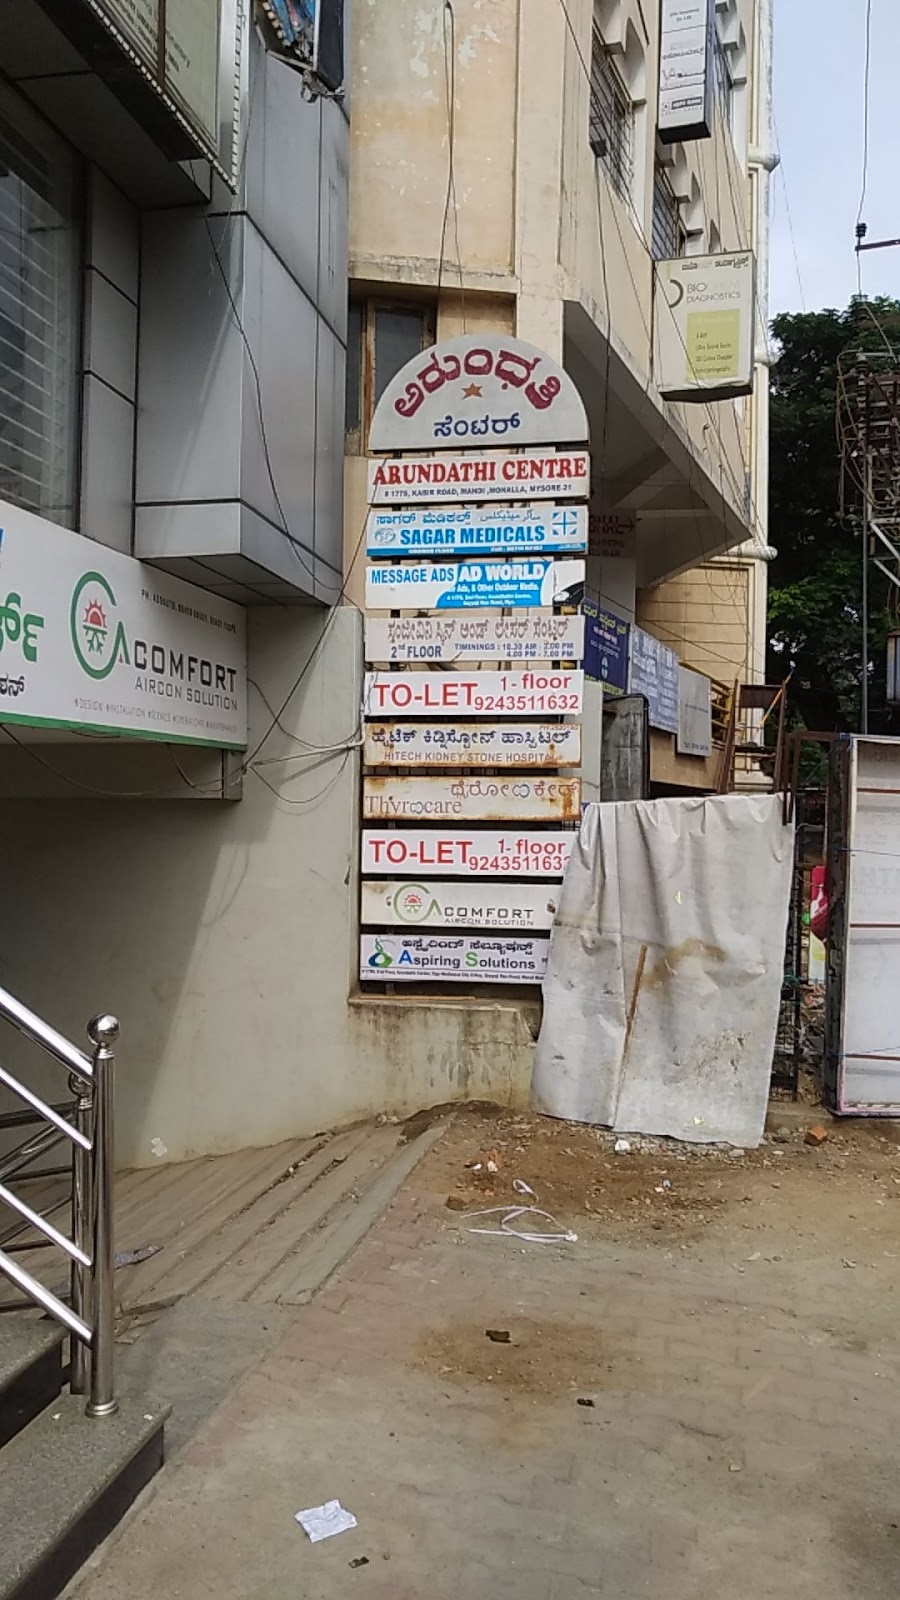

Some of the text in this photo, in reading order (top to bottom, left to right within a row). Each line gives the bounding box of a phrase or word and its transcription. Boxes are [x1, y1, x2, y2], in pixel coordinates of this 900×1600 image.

[433, 412, 521, 437] ಸೆಂಟರ್
[372, 457, 587, 486] ARUNDATHI CENTRE
[529, 483, 573, 492] MYSORE-21
[400, 525, 545, 545] SAGAR MEDICALS
[371, 563, 545, 584] MESSAGE ADS AD WORLD
[406, 645, 442, 658] FLOOR
[561, 642, 574, 650] PM
[135, 675, 238, 711] AIRCON SOLUTION
[372, 682, 478, 707] TO-LET
[474, 694, 579, 711] 9243511632
[384, 751, 421, 761] HITECH
[425, 751, 464, 762] KIDNEY
[466, 752, 502, 762] STONE
[369, 840, 473, 864] TO-LET
[484, 918, 535, 926] SOLUTION
[398, 949, 461, 969] Aspiring
[465, 951, 536, 969] Solutions
